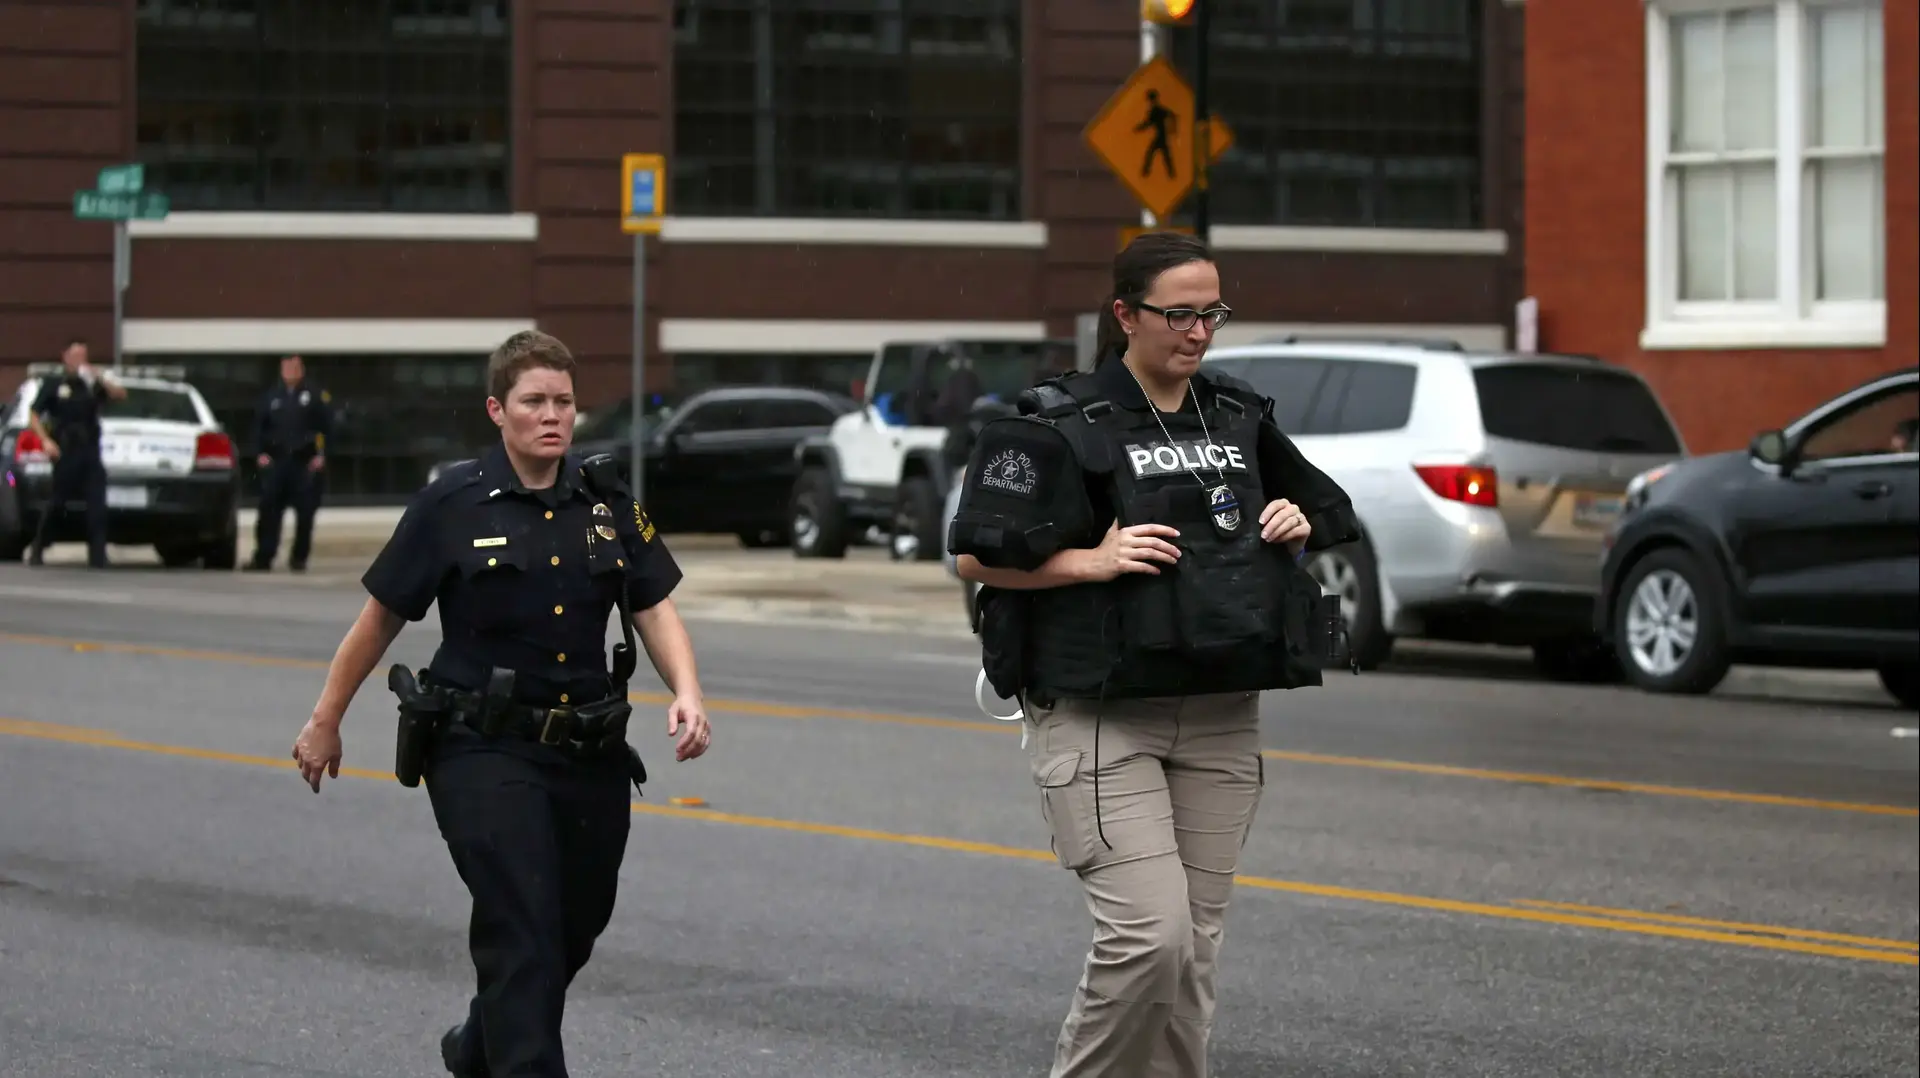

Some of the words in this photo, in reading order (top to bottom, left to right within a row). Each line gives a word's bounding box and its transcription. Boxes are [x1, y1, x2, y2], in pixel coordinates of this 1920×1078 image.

[983, 449, 1015, 476] DALLAS
[1016, 452, 1036, 485] POLICE
[1129, 444, 1247, 475] POLICE
[982, 476, 1033, 494] DEPARTMENT
